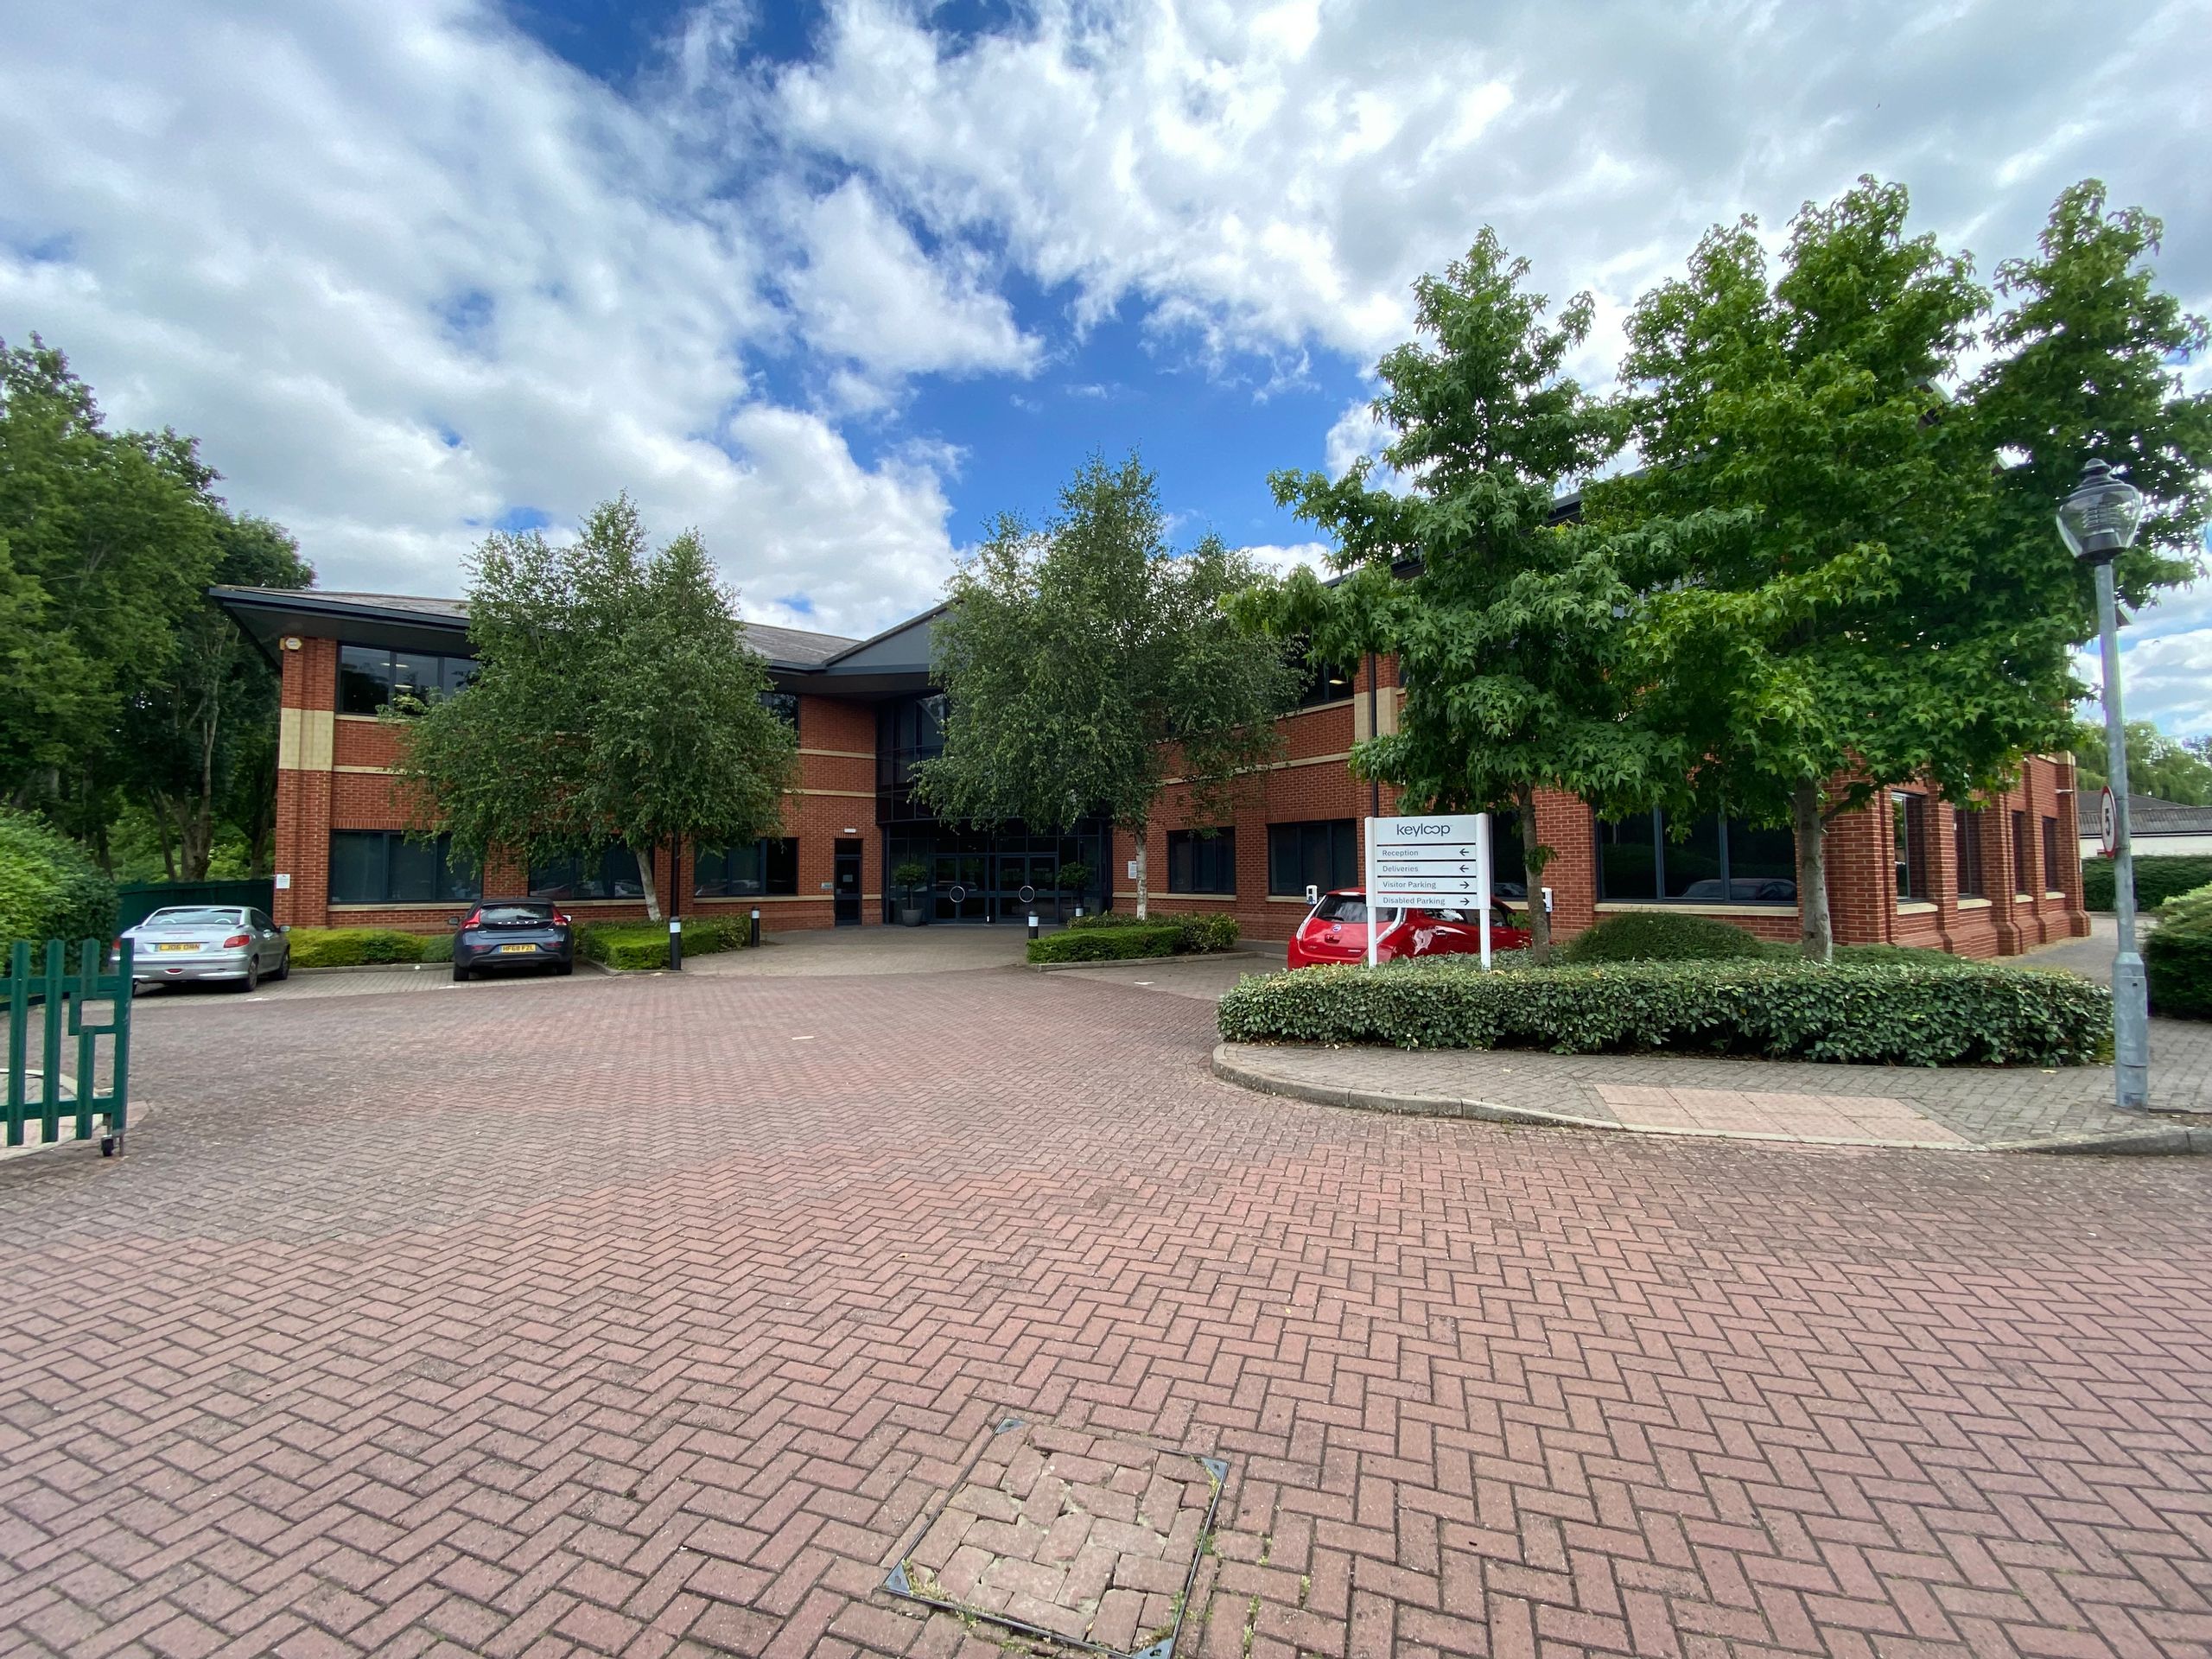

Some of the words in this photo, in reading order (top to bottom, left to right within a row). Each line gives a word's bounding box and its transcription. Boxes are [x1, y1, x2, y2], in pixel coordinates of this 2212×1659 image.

[2105, 808, 2111, 836] 5
[1396, 823, 1450, 836] keyloop
[1408, 880, 1437, 889] Parking
[1416, 897, 1446, 906] Parking
